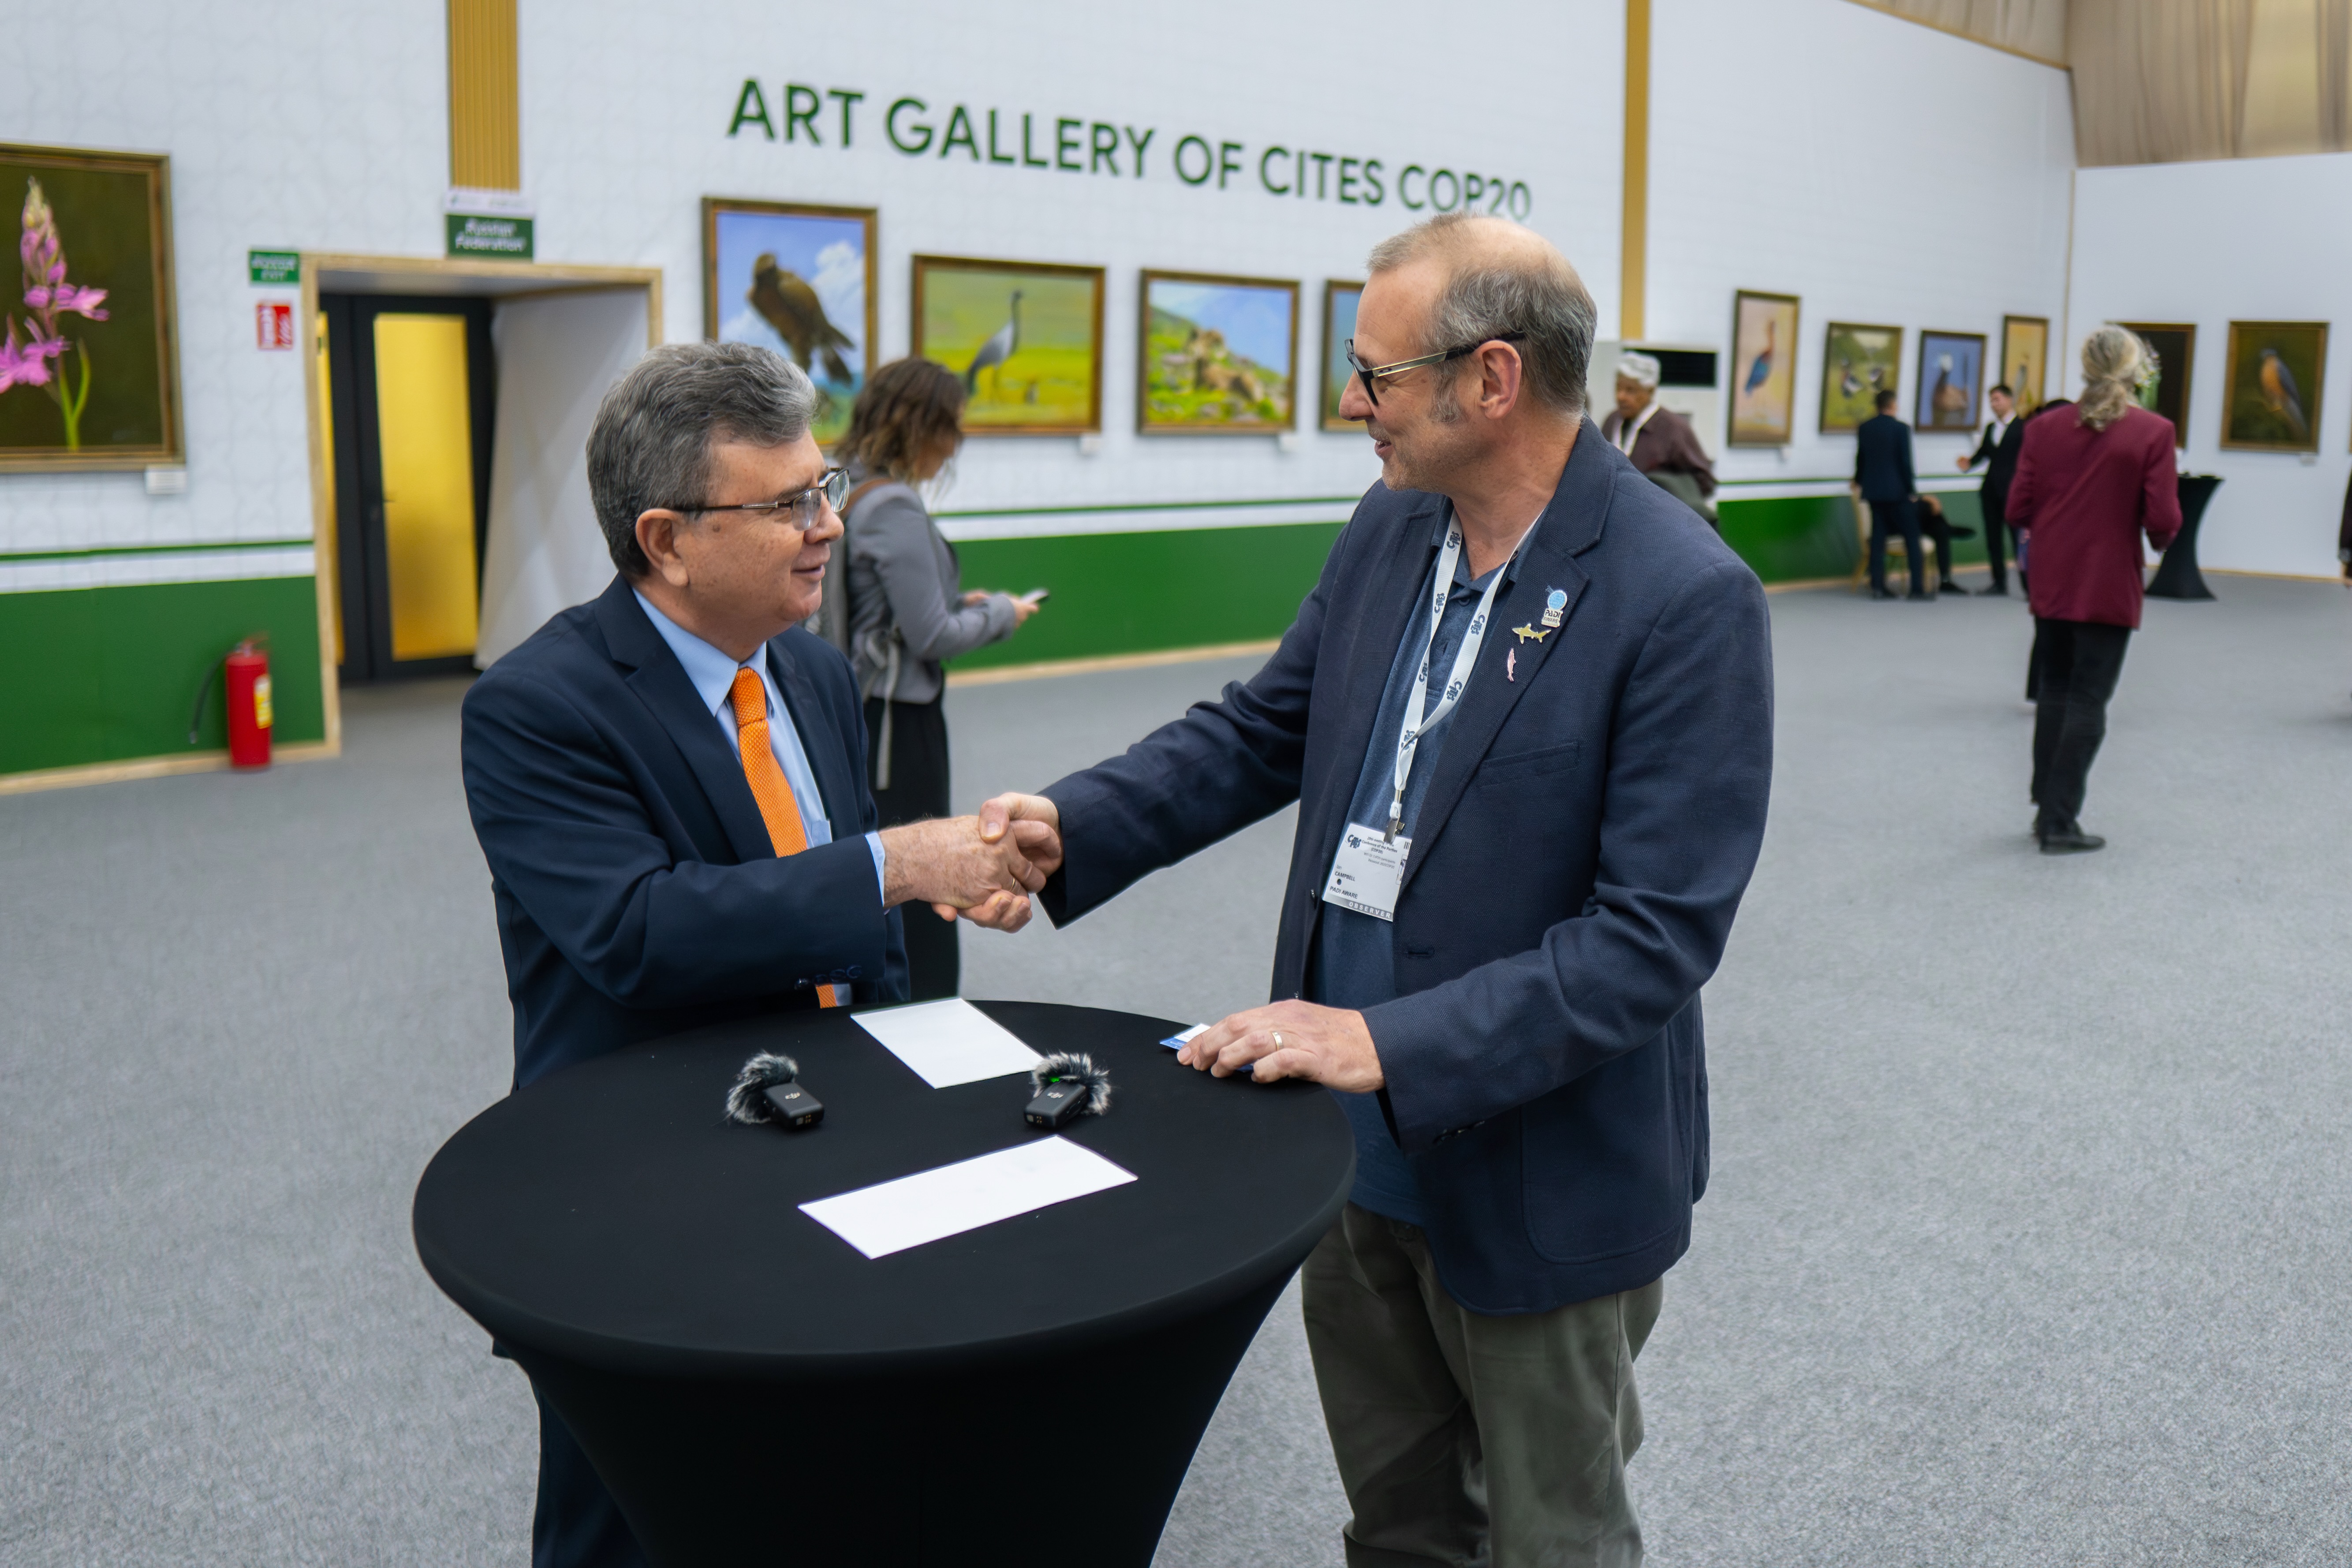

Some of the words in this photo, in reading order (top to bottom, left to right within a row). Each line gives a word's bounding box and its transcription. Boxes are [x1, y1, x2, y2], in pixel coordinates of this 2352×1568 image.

[728, 79, 864, 147] ART
[885, 97, 1154, 178] GALLERY
[1175, 135, 1242, 189] OF
[1260, 146, 1384, 204] CITES
[1399, 165, 1530, 220] COP20
[455, 232, 523, 252] Federation
[1335, 871, 1355, 881] CAMPBELL
[1341, 890, 1359, 899] AWARE
[1349, 902, 1390, 918] OBSERVER
